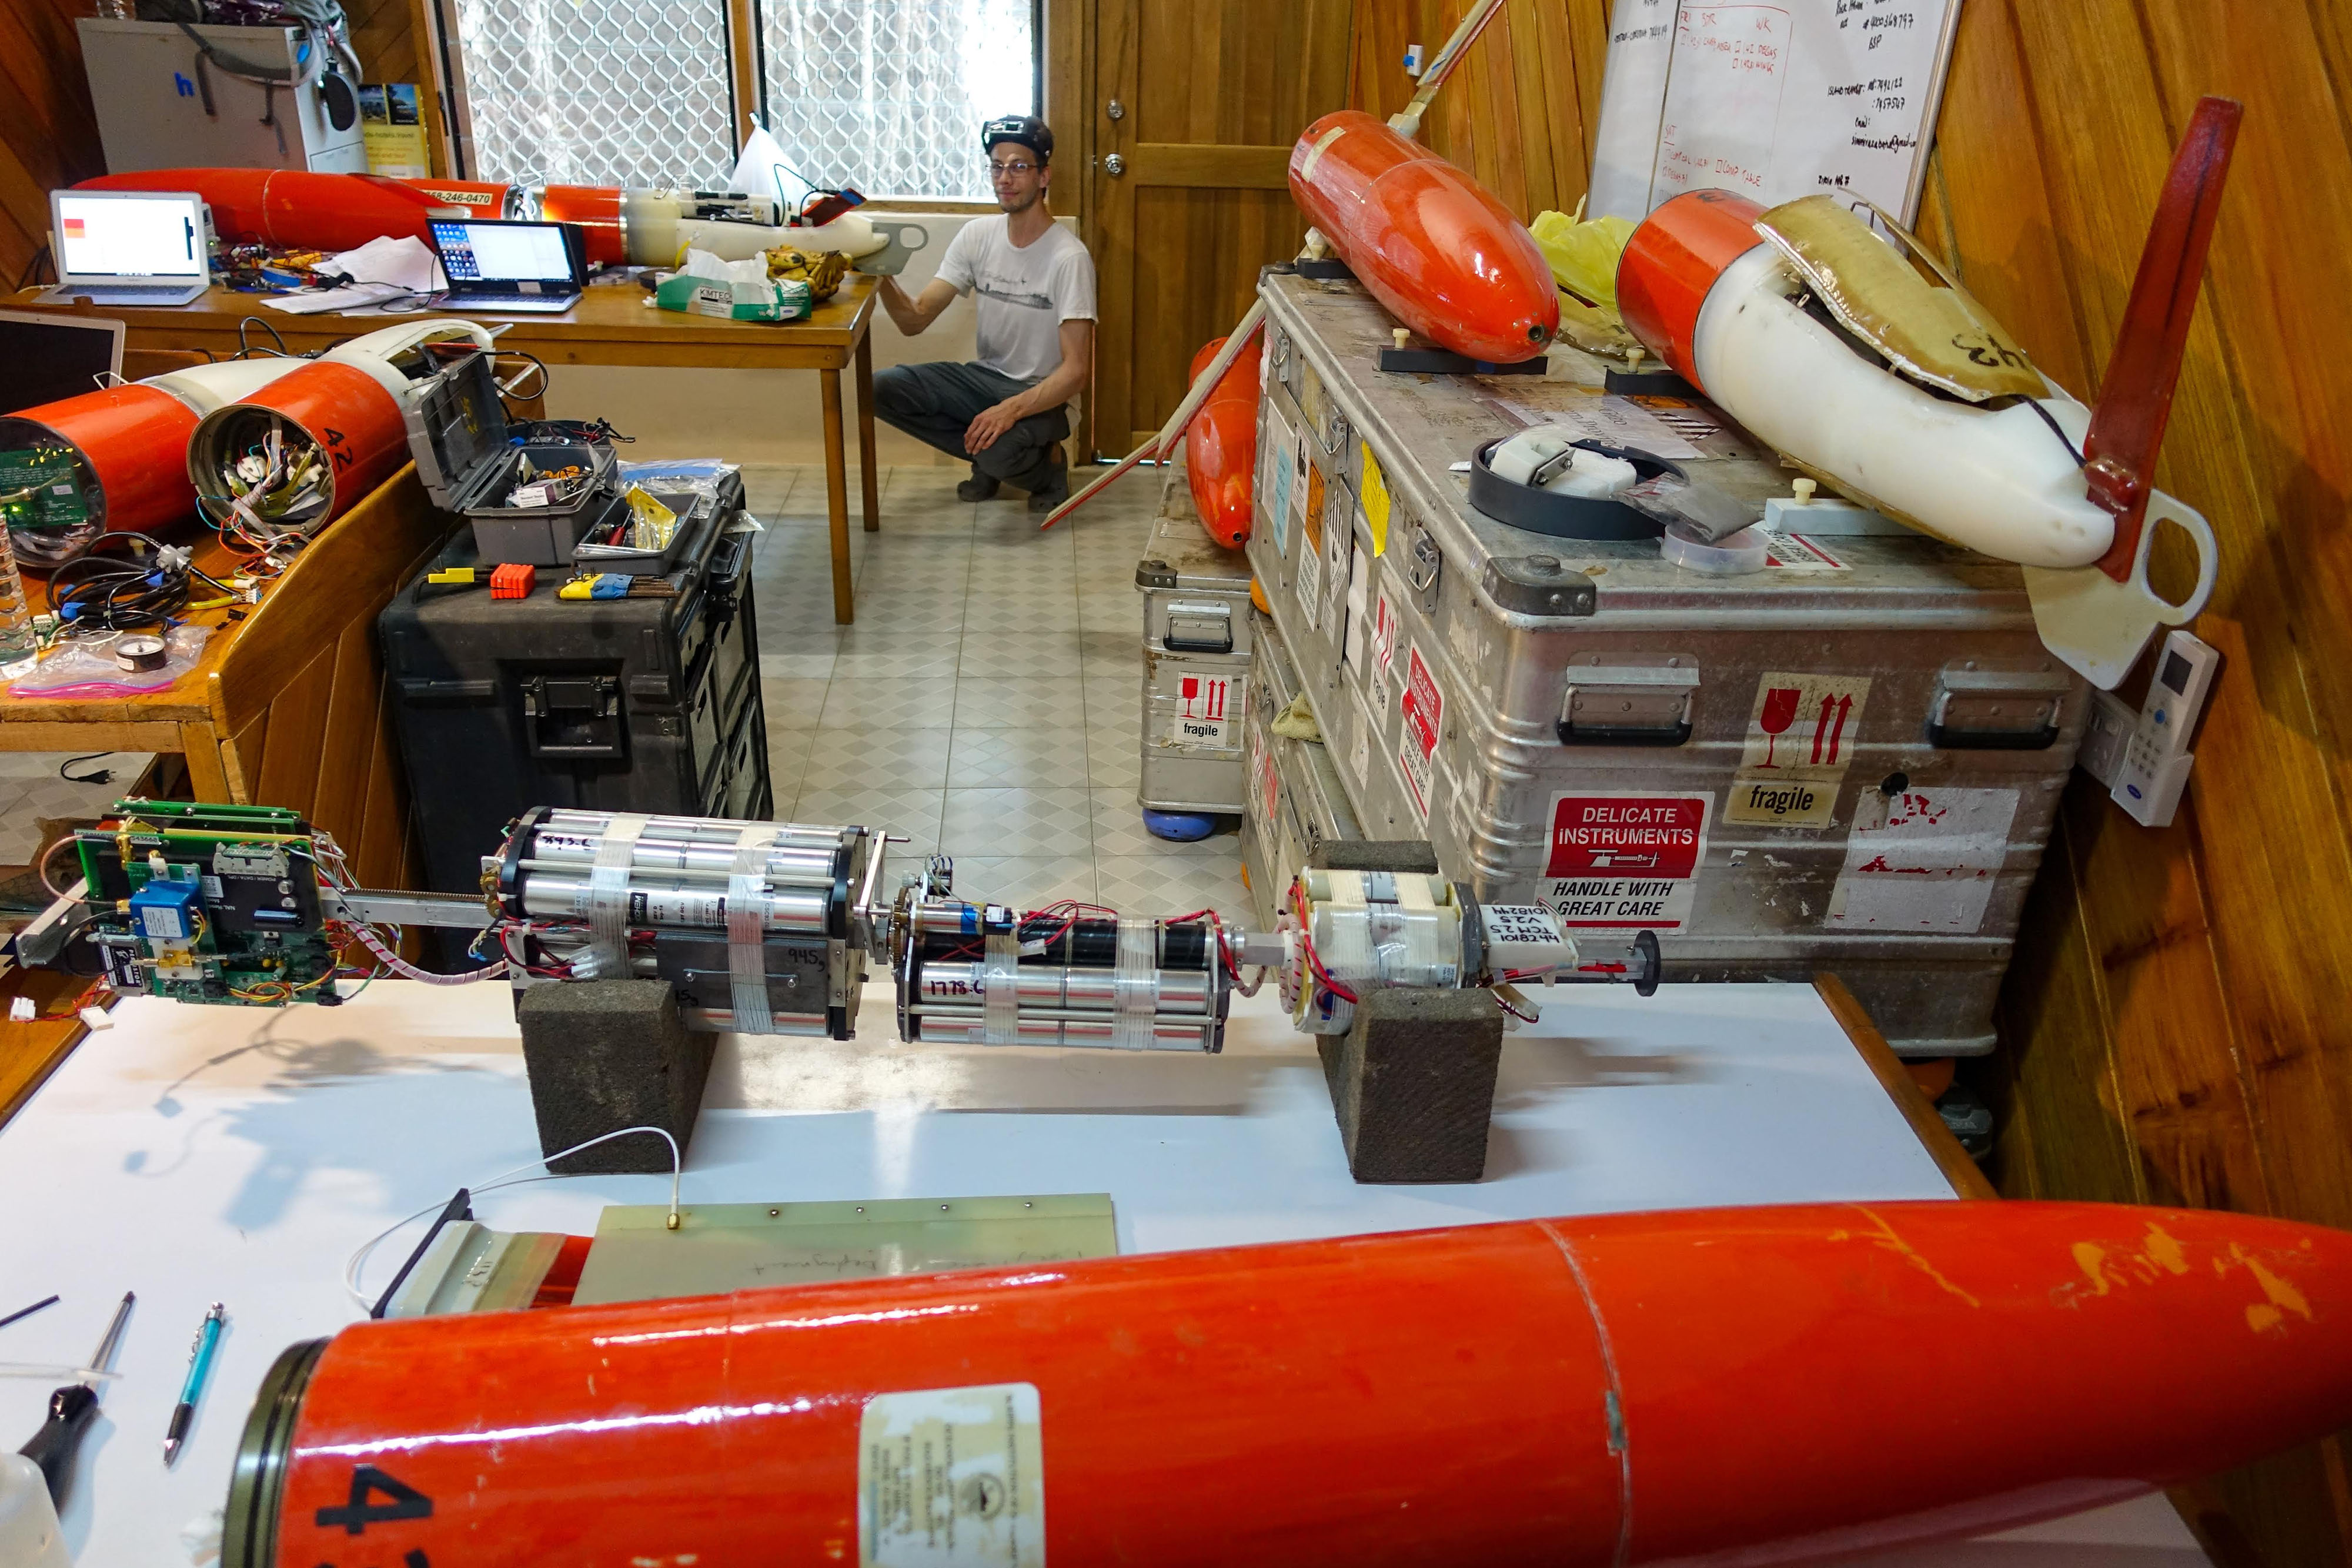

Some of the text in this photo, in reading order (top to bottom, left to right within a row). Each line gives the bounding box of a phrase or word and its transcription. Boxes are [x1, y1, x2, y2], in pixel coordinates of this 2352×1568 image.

[323, 427, 353, 472] 42
[1415, 664, 1435, 712] DELICATE
[1409, 675, 1437, 738] INSTRUMENTS
[1184, 723, 1218, 737] fragile
[1405, 725, 1429, 783] HANDLE WITH
[1404, 745, 1426, 798] GREAT CARE
[1749, 785, 1814, 814] fragile
[1582, 807, 1677, 823] DELICATE
[1559, 828, 1693, 845] INSTRUMENTS
[1553, 882, 1674, 897] HANDLE WITH
[1492, 907, 1548, 915] 1018244
[1557, 901, 1665, 915] GREAT CARE
[1501, 934, 1560, 943] 1018244
[931, 979, 985, 995] 1778.6
